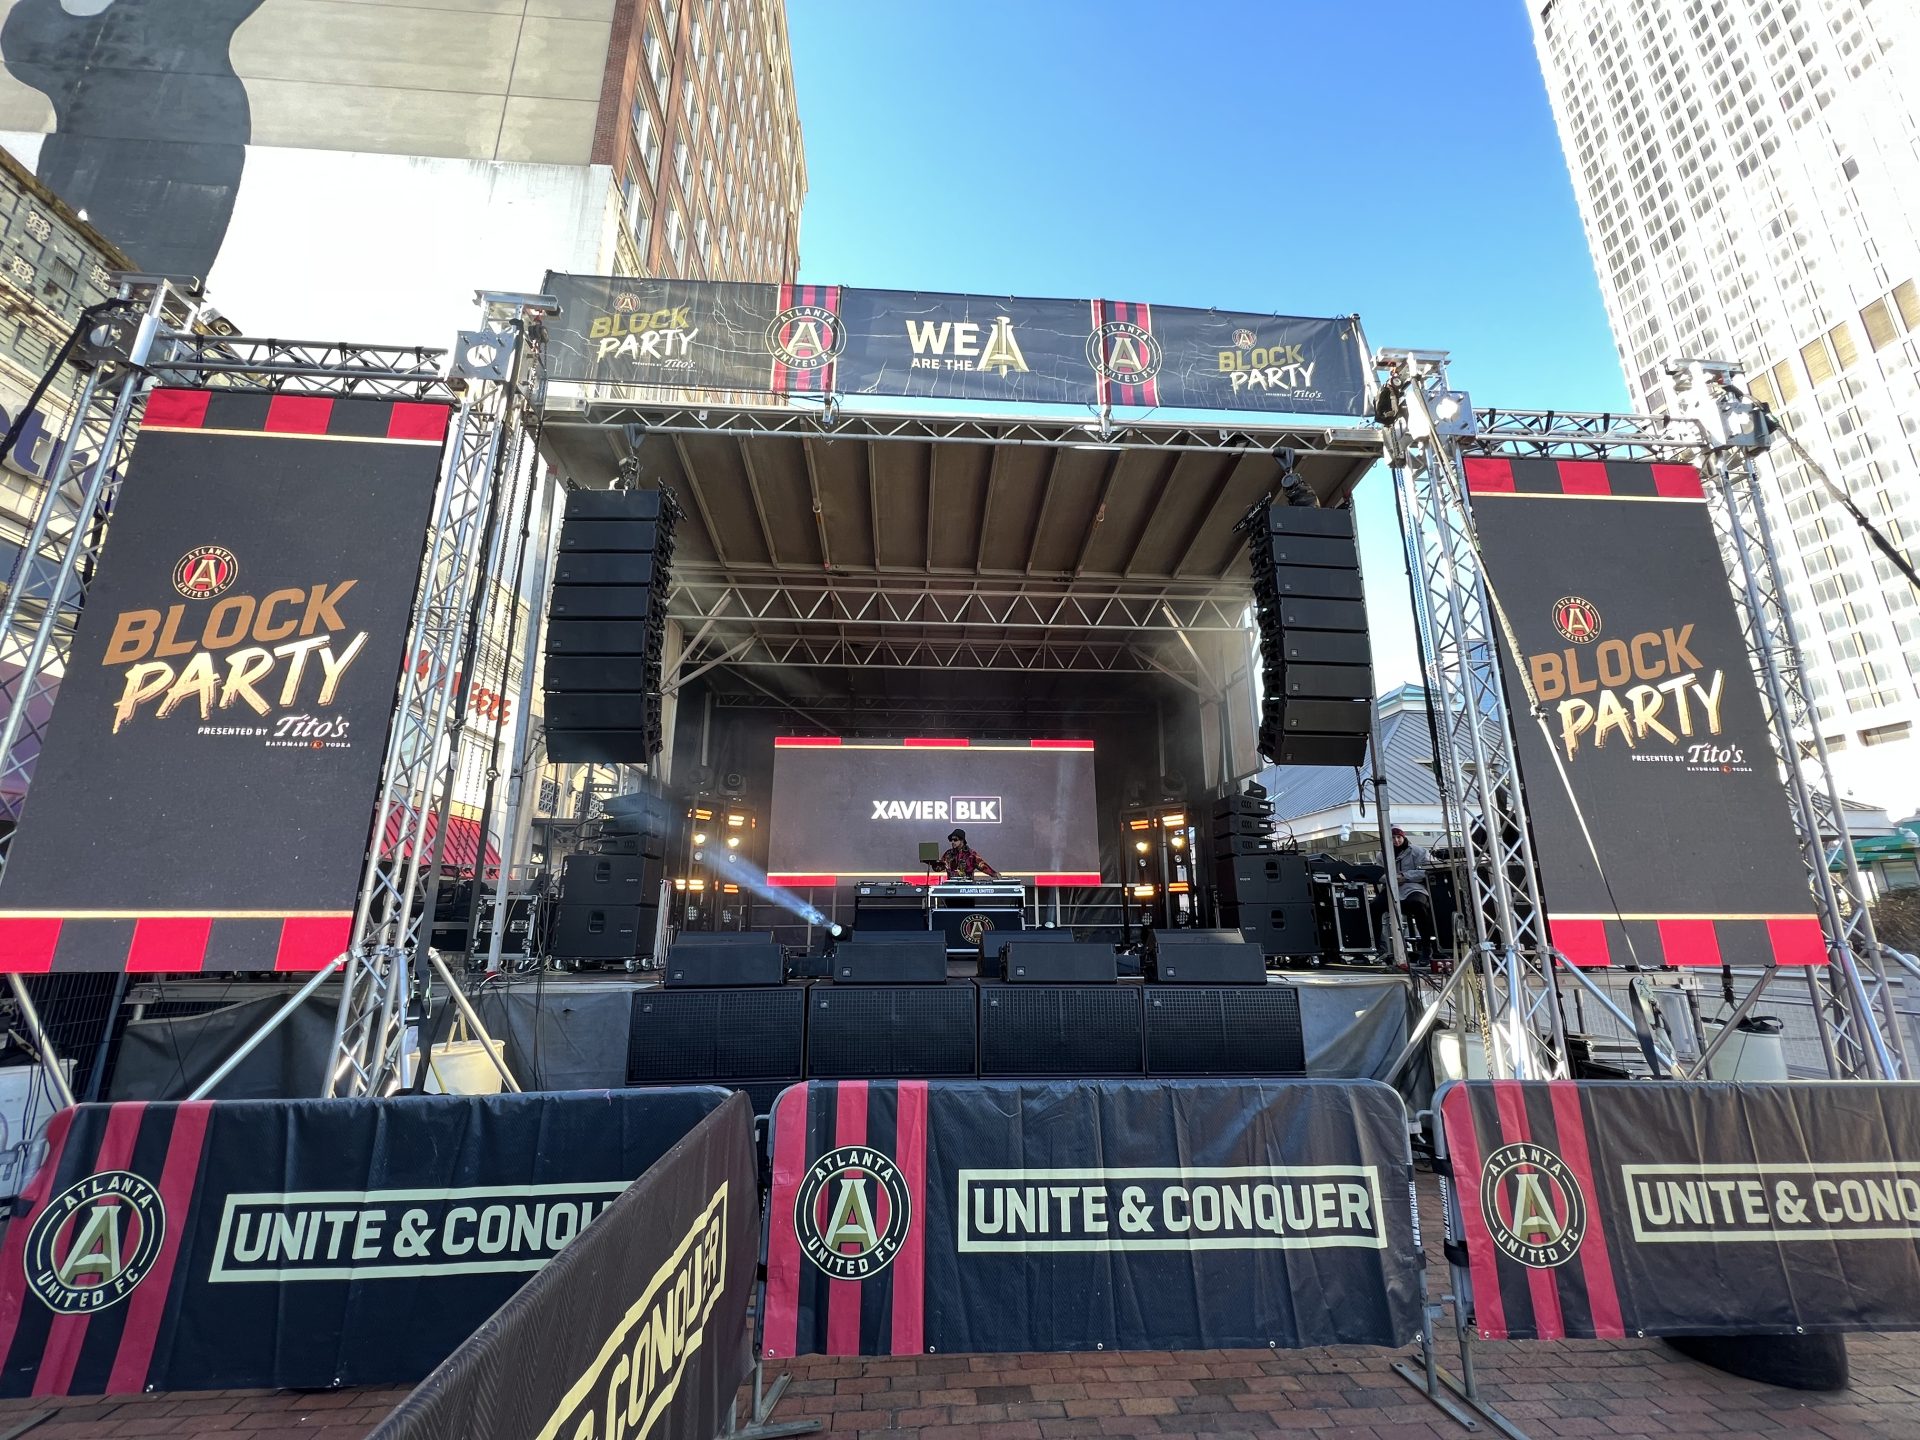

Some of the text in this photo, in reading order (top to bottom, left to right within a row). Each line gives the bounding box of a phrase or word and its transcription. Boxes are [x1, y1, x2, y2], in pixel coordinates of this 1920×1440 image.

[590, 307, 690, 338] BLOCK
[780, 308, 835, 324] ATLANTA
[597, 327, 699, 363] PARTY
[905, 320, 980, 356] WE
[775, 347, 818, 367] UNITED
[911, 358, 974, 371] ARE THE
[1142, 367, 1155, 378] FC
[1218, 344, 1305, 372] BLOCK
[1229, 361, 1315, 396] PARTY
[1293, 390, 1322, 399] Tito's
[189, 547, 232, 562] ATLANTA
[178, 582, 210, 597] UNITED
[1557, 598, 1590, 610] ATLANTA
[102, 579, 359, 666] BLOCK
[1561, 629, 1589, 642] UNITED
[1529, 623, 1704, 701] BLOCK
[112, 631, 369, 734] PARTY
[197, 714, 350, 738] PRESENTED BY Tito's
[1555, 669, 1724, 762] PARTY
[1688, 743, 1744, 763] Tito's
[871, 800, 997, 819] XAVIER BLK
[815, 1150, 894, 1181] ATLANTA
[1489, 1147, 1562, 1176] ATLANTA
[63, 1176, 154, 1210] ATLANTA
[1638, 1180, 1770, 1226] UNITE
[1774, 1179, 1812, 1224] &
[974, 1183, 1373, 1235] UNITE & CONQUER
[233, 1209, 387, 1262] UNITE
[393, 1208, 437, 1258] &
[1497, 1228, 1579, 1263] UNITED FC
[807, 1236, 896, 1275] UNITED FC
[37, 1268, 139, 1308] UNITED FC
